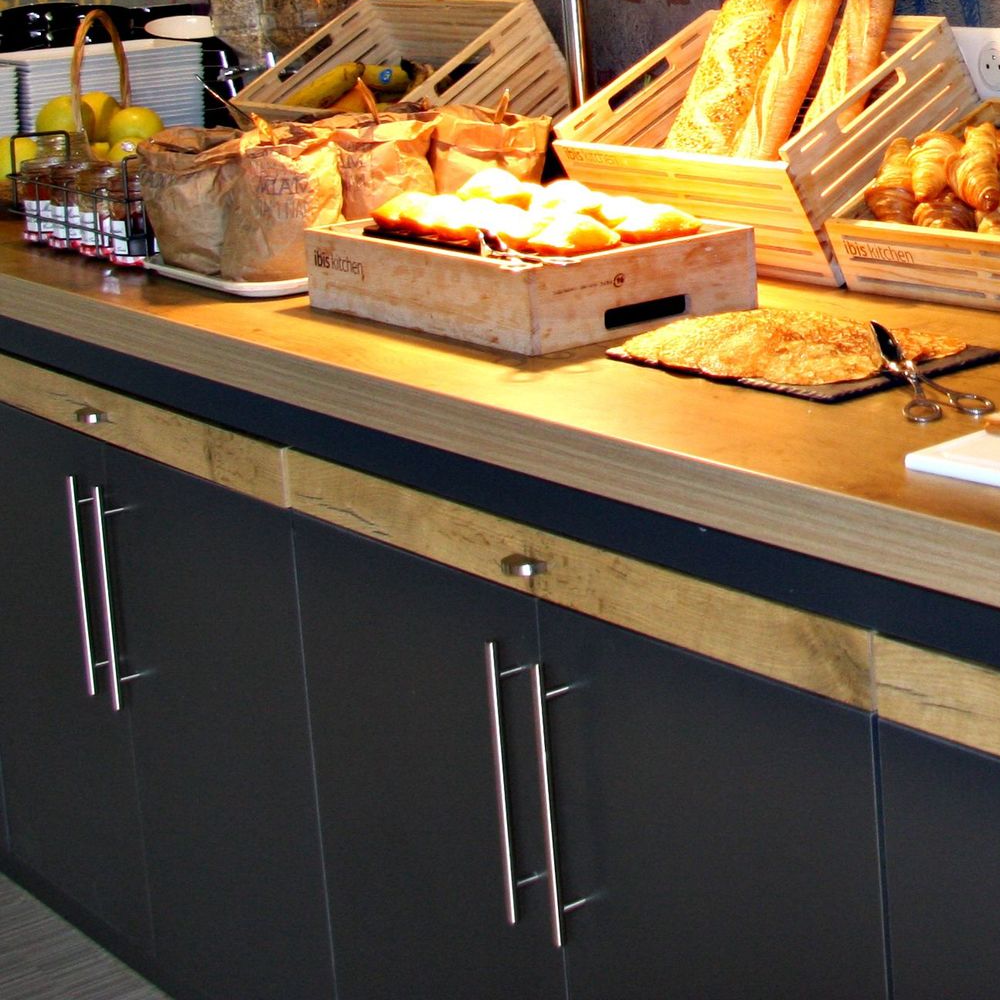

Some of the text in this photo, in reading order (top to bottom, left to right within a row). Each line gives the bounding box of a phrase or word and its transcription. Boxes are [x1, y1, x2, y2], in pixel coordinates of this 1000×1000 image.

[313, 248, 365, 281] ibis kitchen
[842, 240, 915, 265] ibis kitchen
